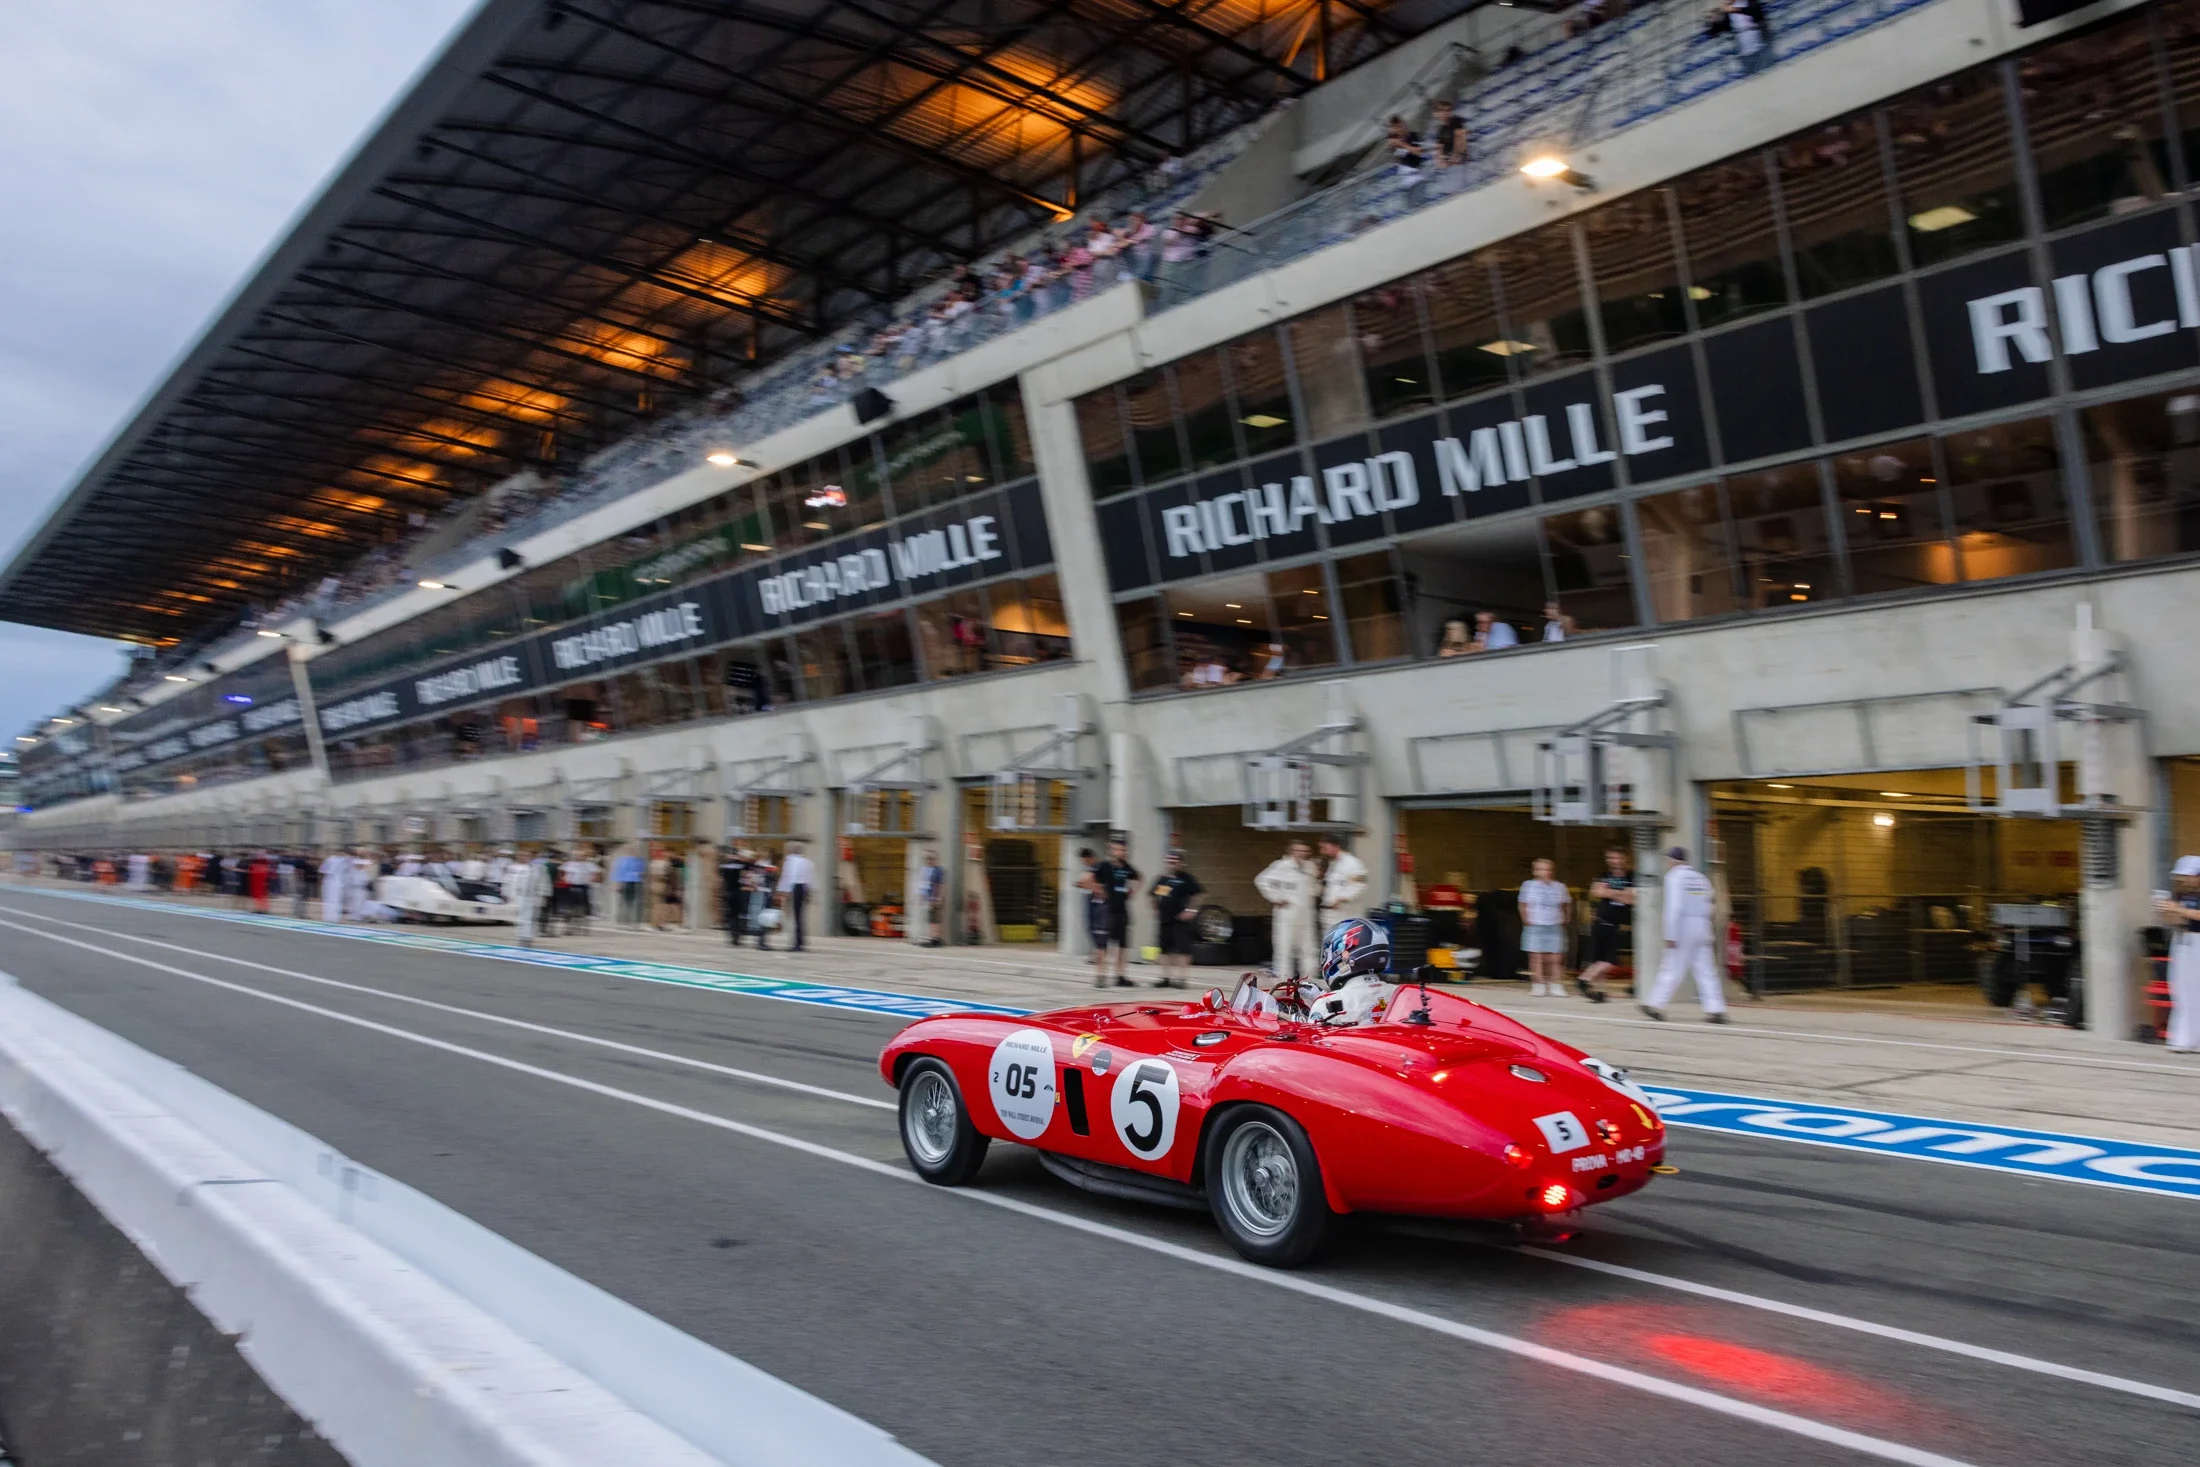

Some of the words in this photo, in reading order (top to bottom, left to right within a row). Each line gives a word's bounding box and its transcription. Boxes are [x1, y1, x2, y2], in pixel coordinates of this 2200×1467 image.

[1162, 450, 1420, 557] RICHARD
[1432, 384, 1675, 497] MILLE
[758, 548, 891, 615] RICHARD
[889, 515, 1002, 581] MILLE
[1005, 1041, 1029, 1051] RICHARD
[1030, 1045, 1048, 1054] MILLE
[993, 1071, 999, 1083] 2
[1005, 1063, 1038, 1099] 05
[1124, 1063, 1170, 1152] 5
[1554, 1119, 1571, 1141] 5
